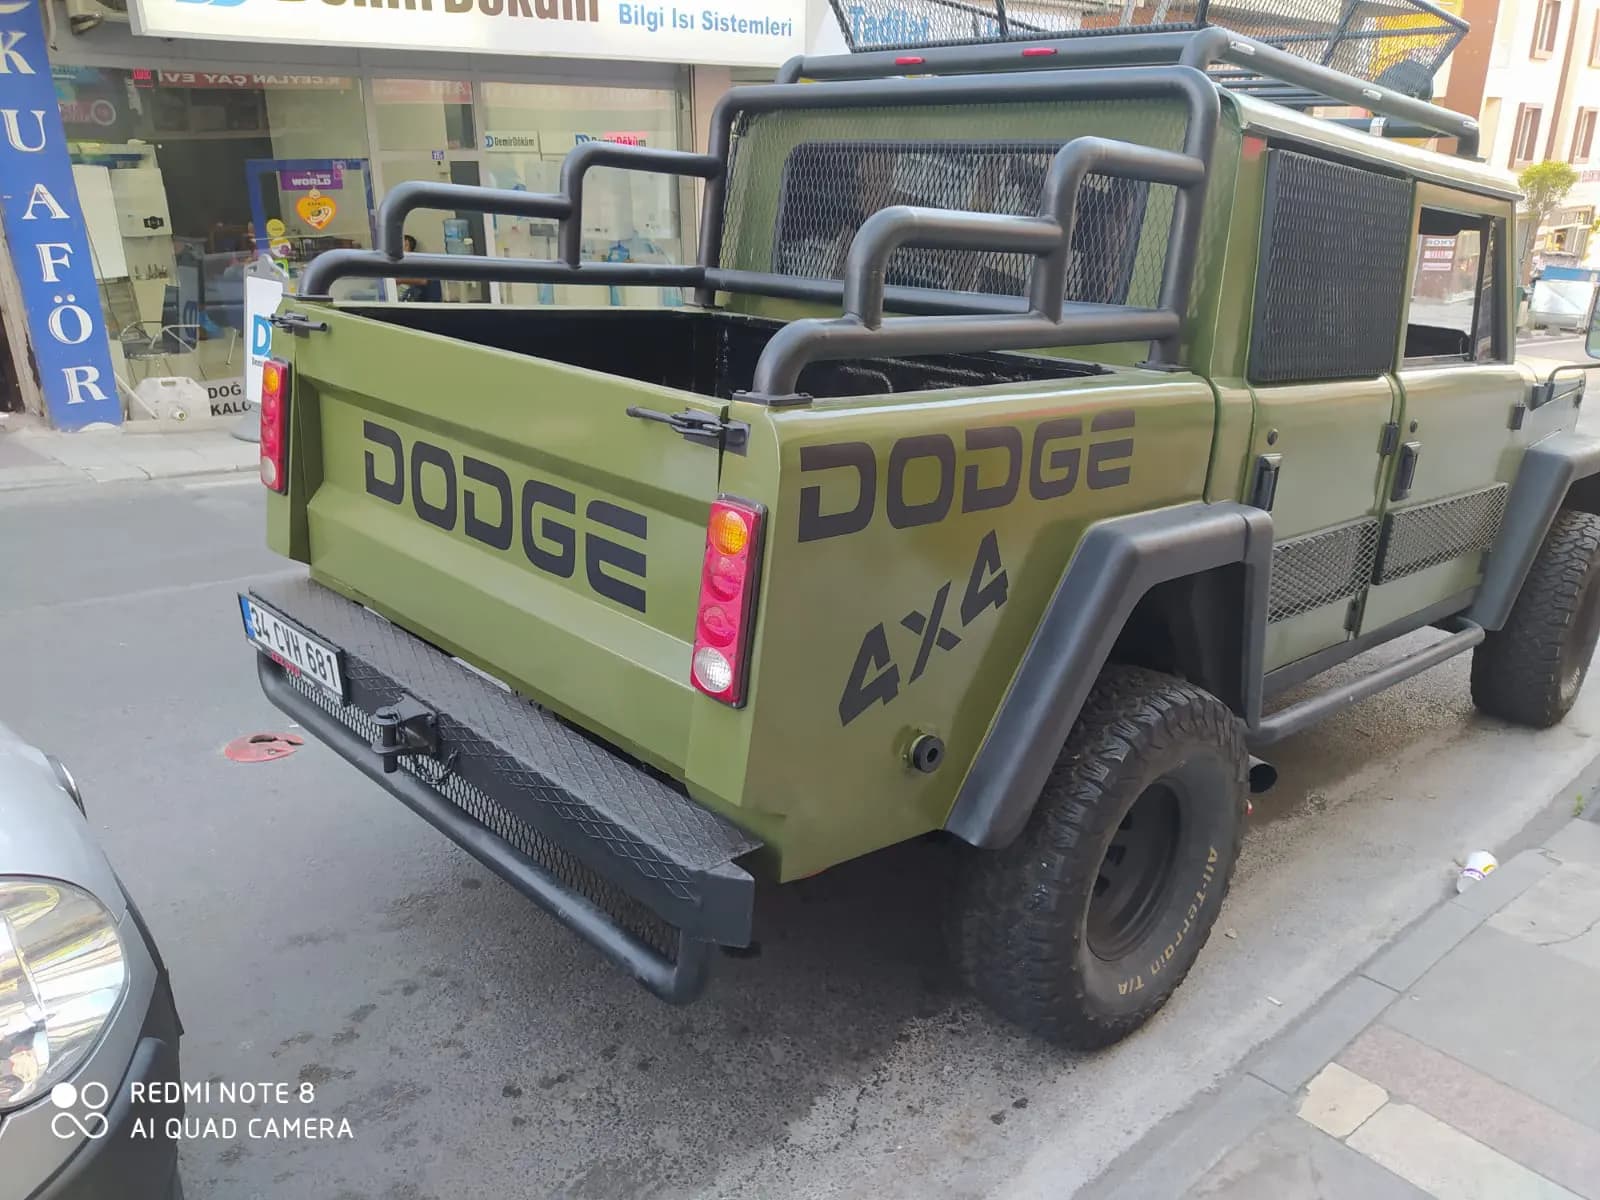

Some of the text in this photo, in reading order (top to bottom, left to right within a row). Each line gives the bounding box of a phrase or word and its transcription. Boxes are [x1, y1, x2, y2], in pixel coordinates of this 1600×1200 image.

[619, 3, 664, 32] Bilgi
[702, 10, 793, 37] Sistemleri
[292, 178, 332, 186] WORLD
[797, 408, 1136, 543] DODGE
[363, 419, 648, 614] DODGE
[250, 606, 272, 645] 34
[273, 621, 303, 667] CVH
[305, 641, 337, 688] 681
[1117, 975, 1145, 995] T/A
